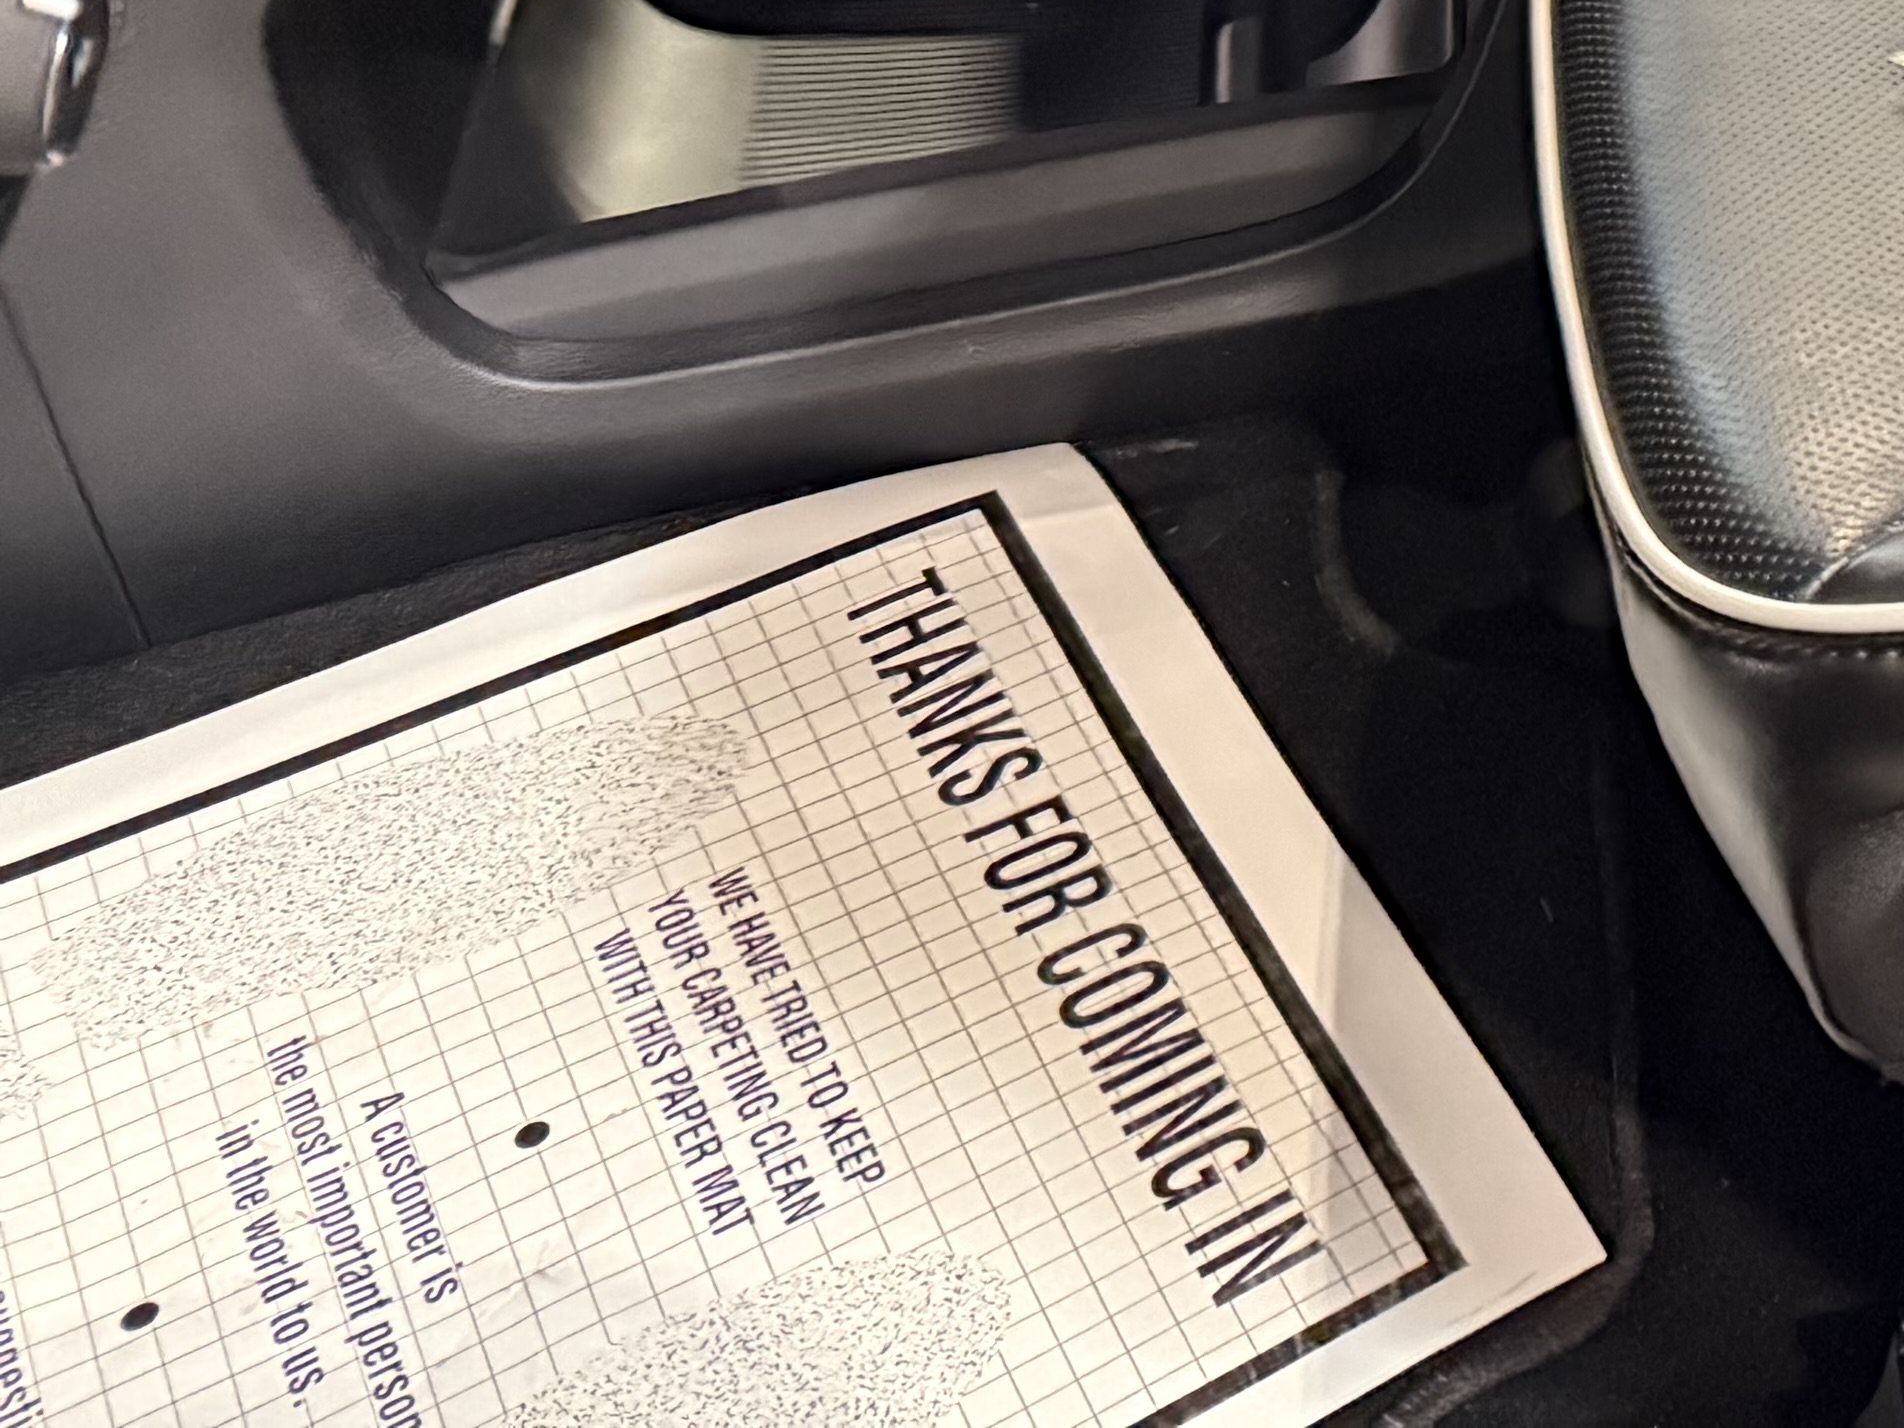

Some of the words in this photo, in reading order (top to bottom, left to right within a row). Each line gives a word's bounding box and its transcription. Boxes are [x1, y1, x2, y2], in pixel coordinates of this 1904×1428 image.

[847, 566, 1043, 806] THANKS
[708, 866, 759, 916] WE
[963, 794, 1112, 936] FOR
[594, 927, 656, 1005] WITH
[727, 911, 791, 986] HAVE
[267, 1034, 308, 1087] the
[623, 998, 683, 1068] THIS
[647, 887, 711, 970] YOUR
[681, 967, 780, 1122] CARPETING
[749, 1120, 826, 1226] CLEAN
[760, 980, 829, 1065] TRIED
[800, 1060, 849, 1110] TO
[1037, 923, 1266, 1211] COMING
[215, 1118, 260, 1160] in
[282, 1087, 343, 1167] most
[360, 1090, 405, 1123] A
[650, 1065, 723, 1169] PAPER
[225, 1154, 273, 1212] the
[819, 1107, 886, 1184] KEEP
[370, 1120, 447, 1264] customer
[691, 1164, 755, 1236] MAT
[243, 1208, 310, 1305] world
[306, 1160, 394, 1322] important
[1184, 1188, 1324, 1308] IN
[420, 1261, 464, 1304] is
[270, 1301, 313, 1346] to
[281, 1345, 325, 1408] us.
